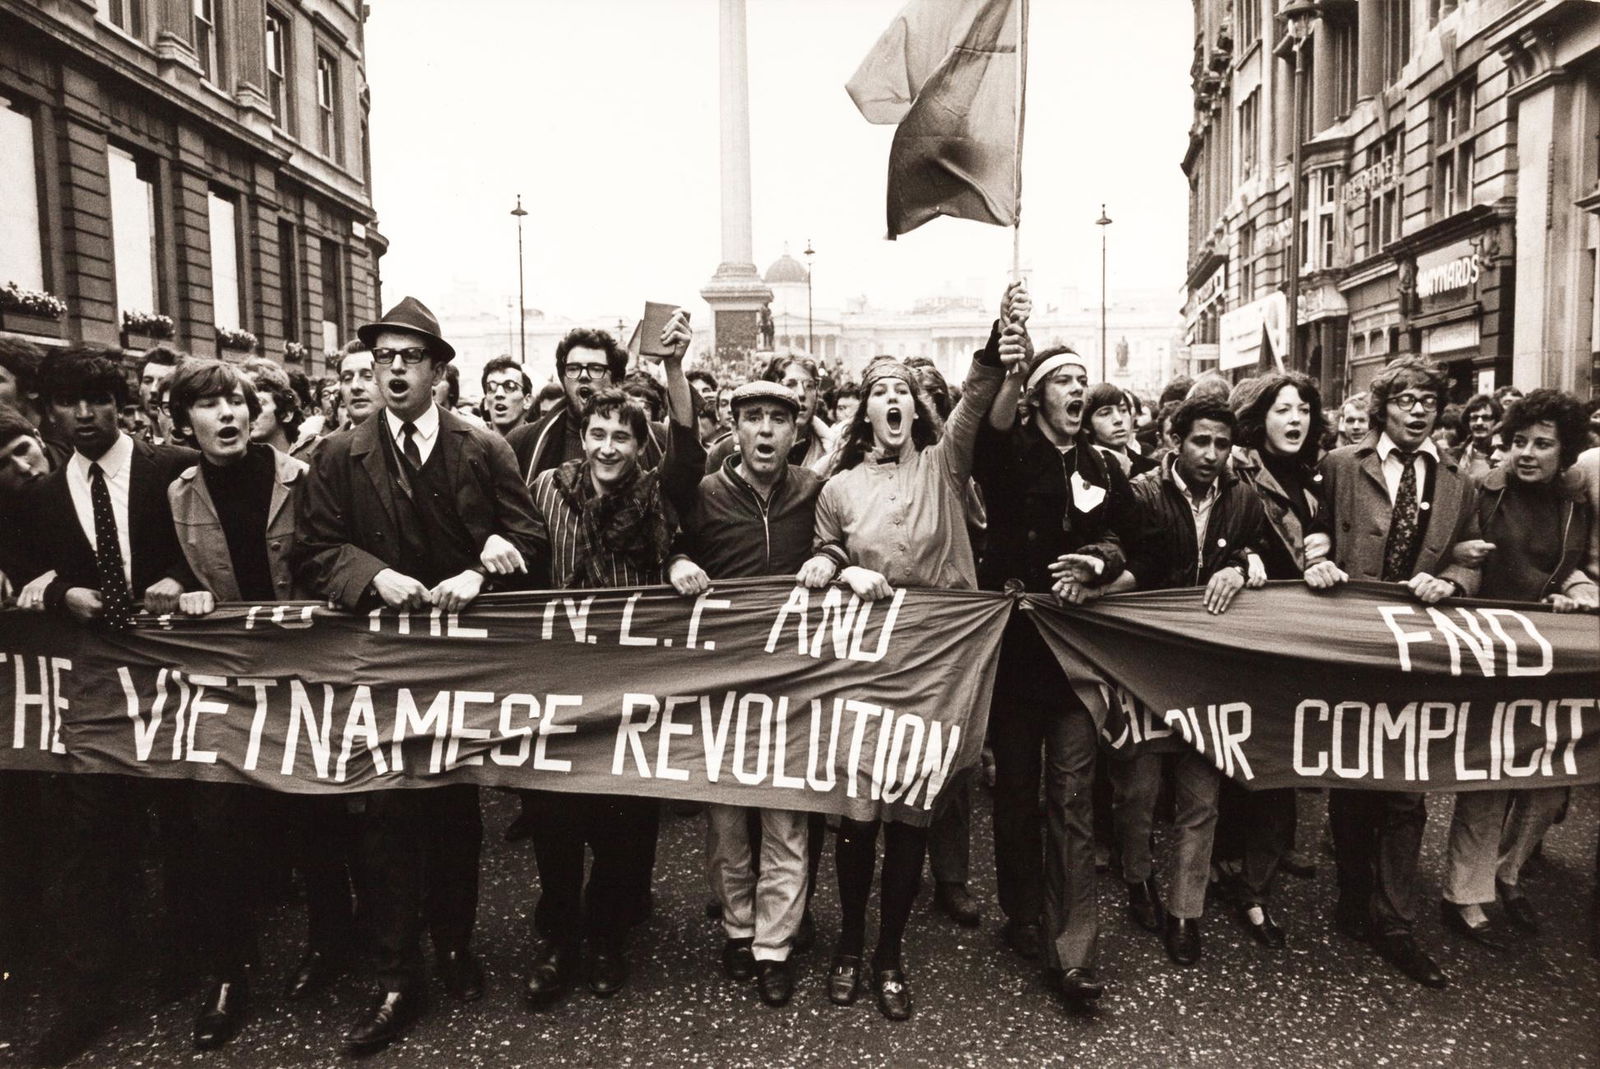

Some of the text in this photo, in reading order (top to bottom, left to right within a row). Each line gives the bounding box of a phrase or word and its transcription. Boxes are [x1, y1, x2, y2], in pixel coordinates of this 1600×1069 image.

[764, 586, 906, 662] AND
[117, 666, 582, 782] VIETNAMESE
[611, 691, 960, 811] REVOLUTION
[1293, 698, 1600, 781] COMPLICIT
